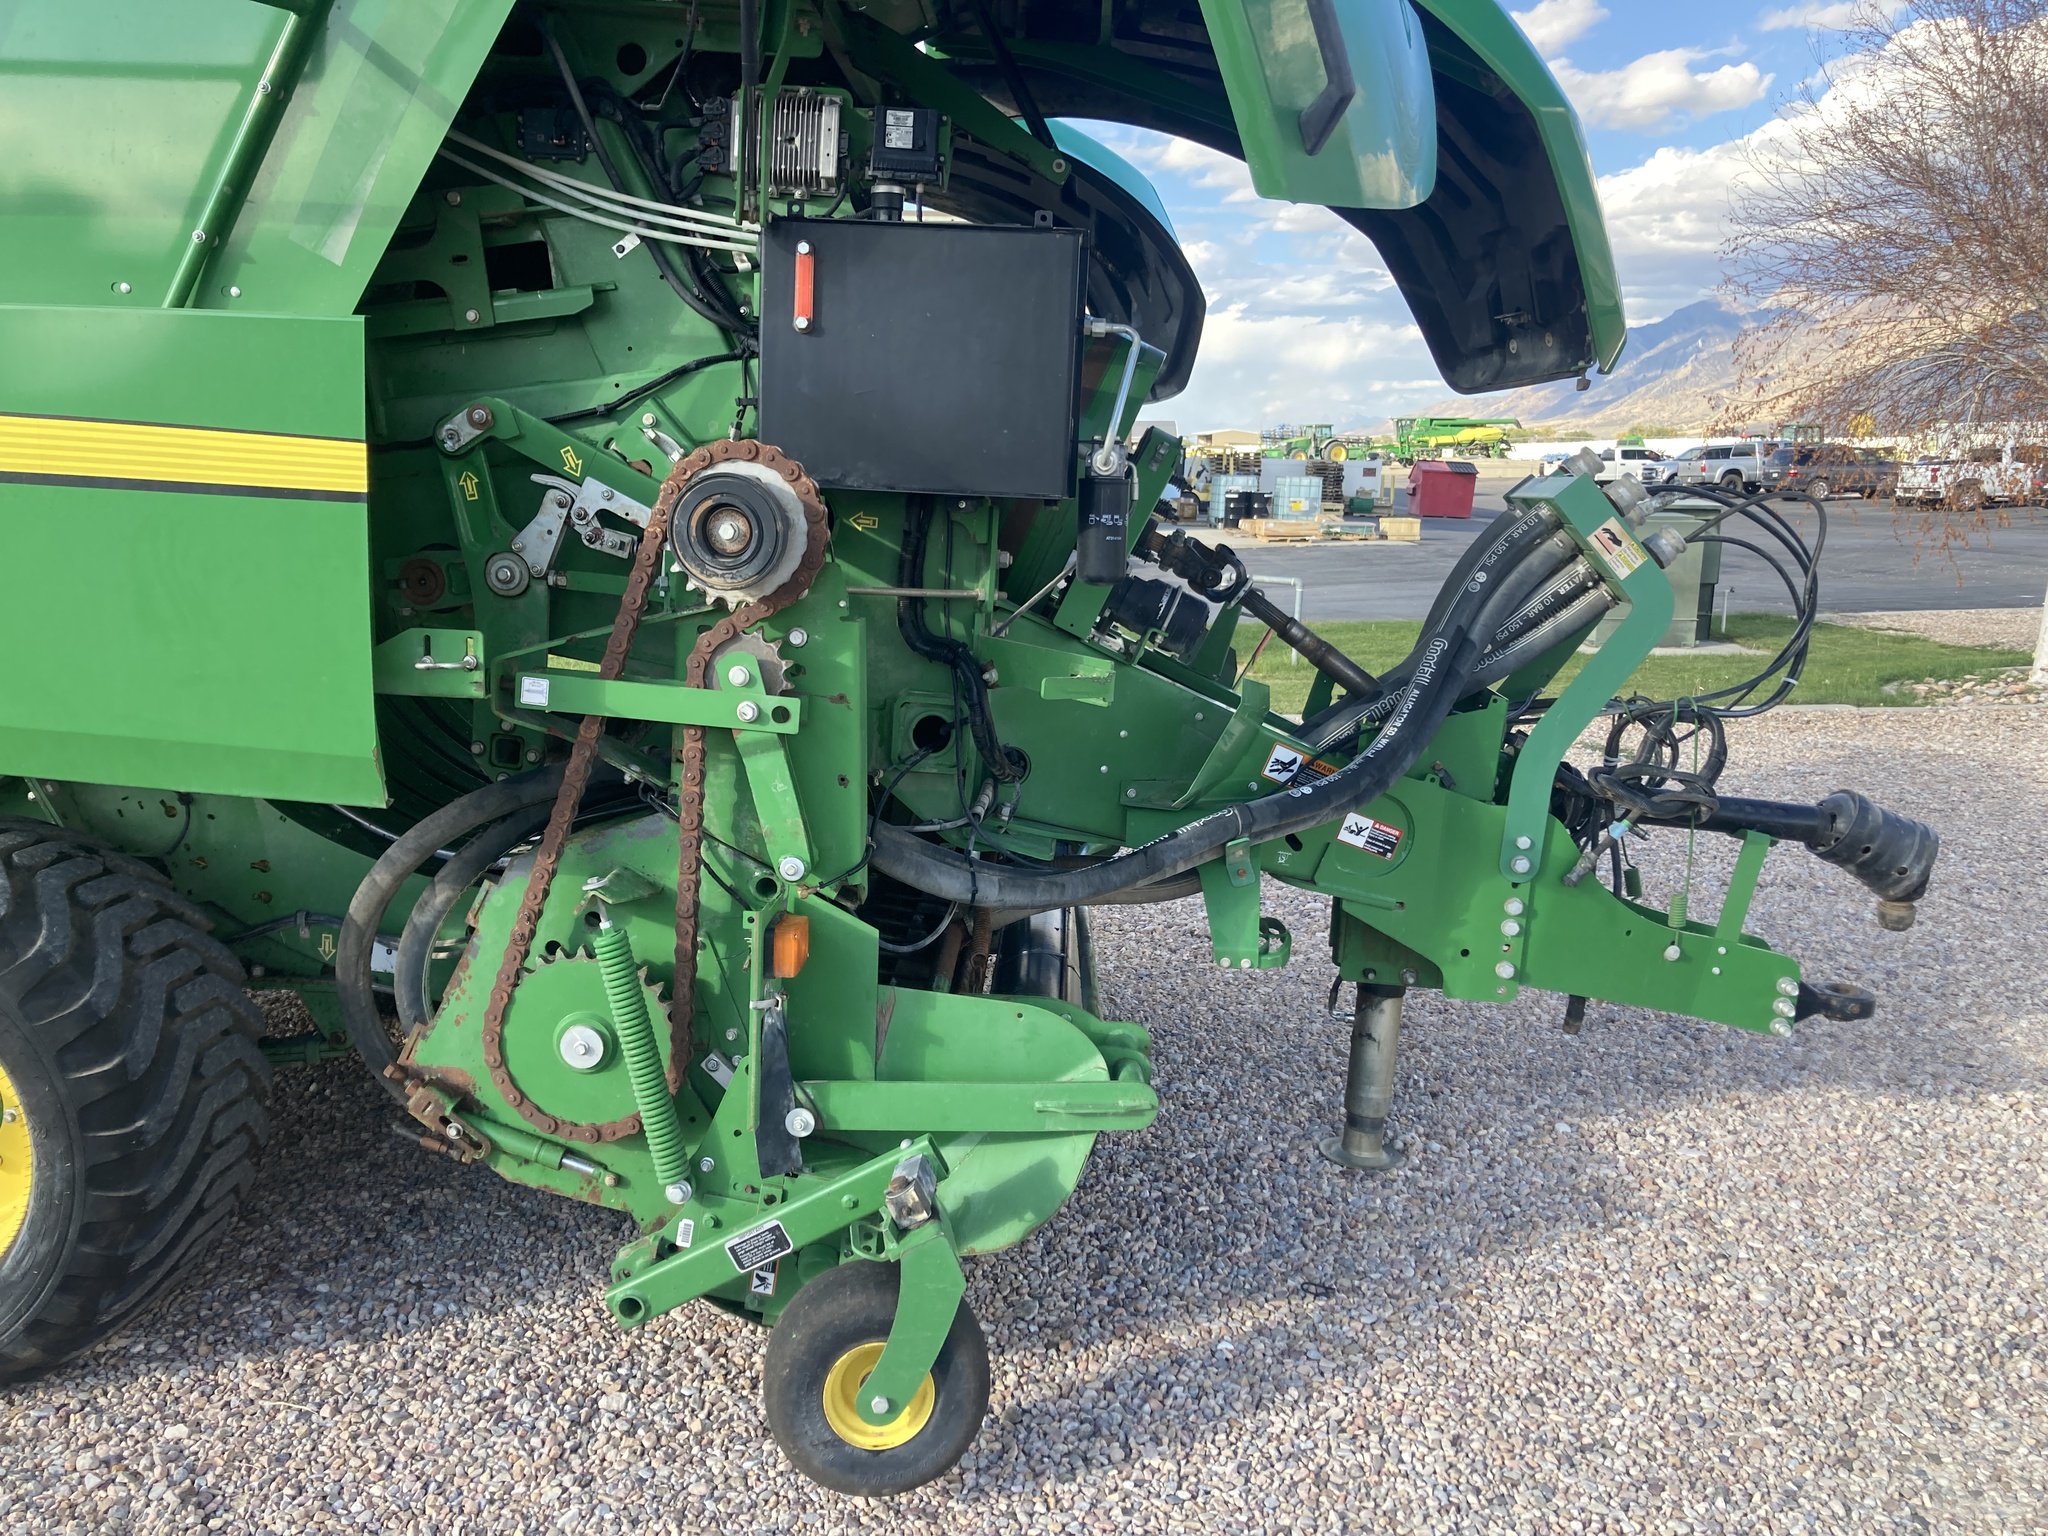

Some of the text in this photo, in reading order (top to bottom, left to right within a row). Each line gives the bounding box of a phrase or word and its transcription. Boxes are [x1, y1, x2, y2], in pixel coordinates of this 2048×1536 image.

[1527, 516, 1538, 526] 10
[1511, 523, 1528, 538] BAR
[1494, 541, 1509, 555] 150
[1485, 553, 1498, 566] PSI
[1543, 595, 1555, 606] 10
[1527, 603, 1545, 619] BAR
[1508, 619, 1523, 632] 150
[1495, 629, 1509, 641] PSI
[1392, 688, 1420, 727] ALLIGATOR
[1386, 726, 1398, 736] SD
[1314, 761, 1338, 775] WARN
